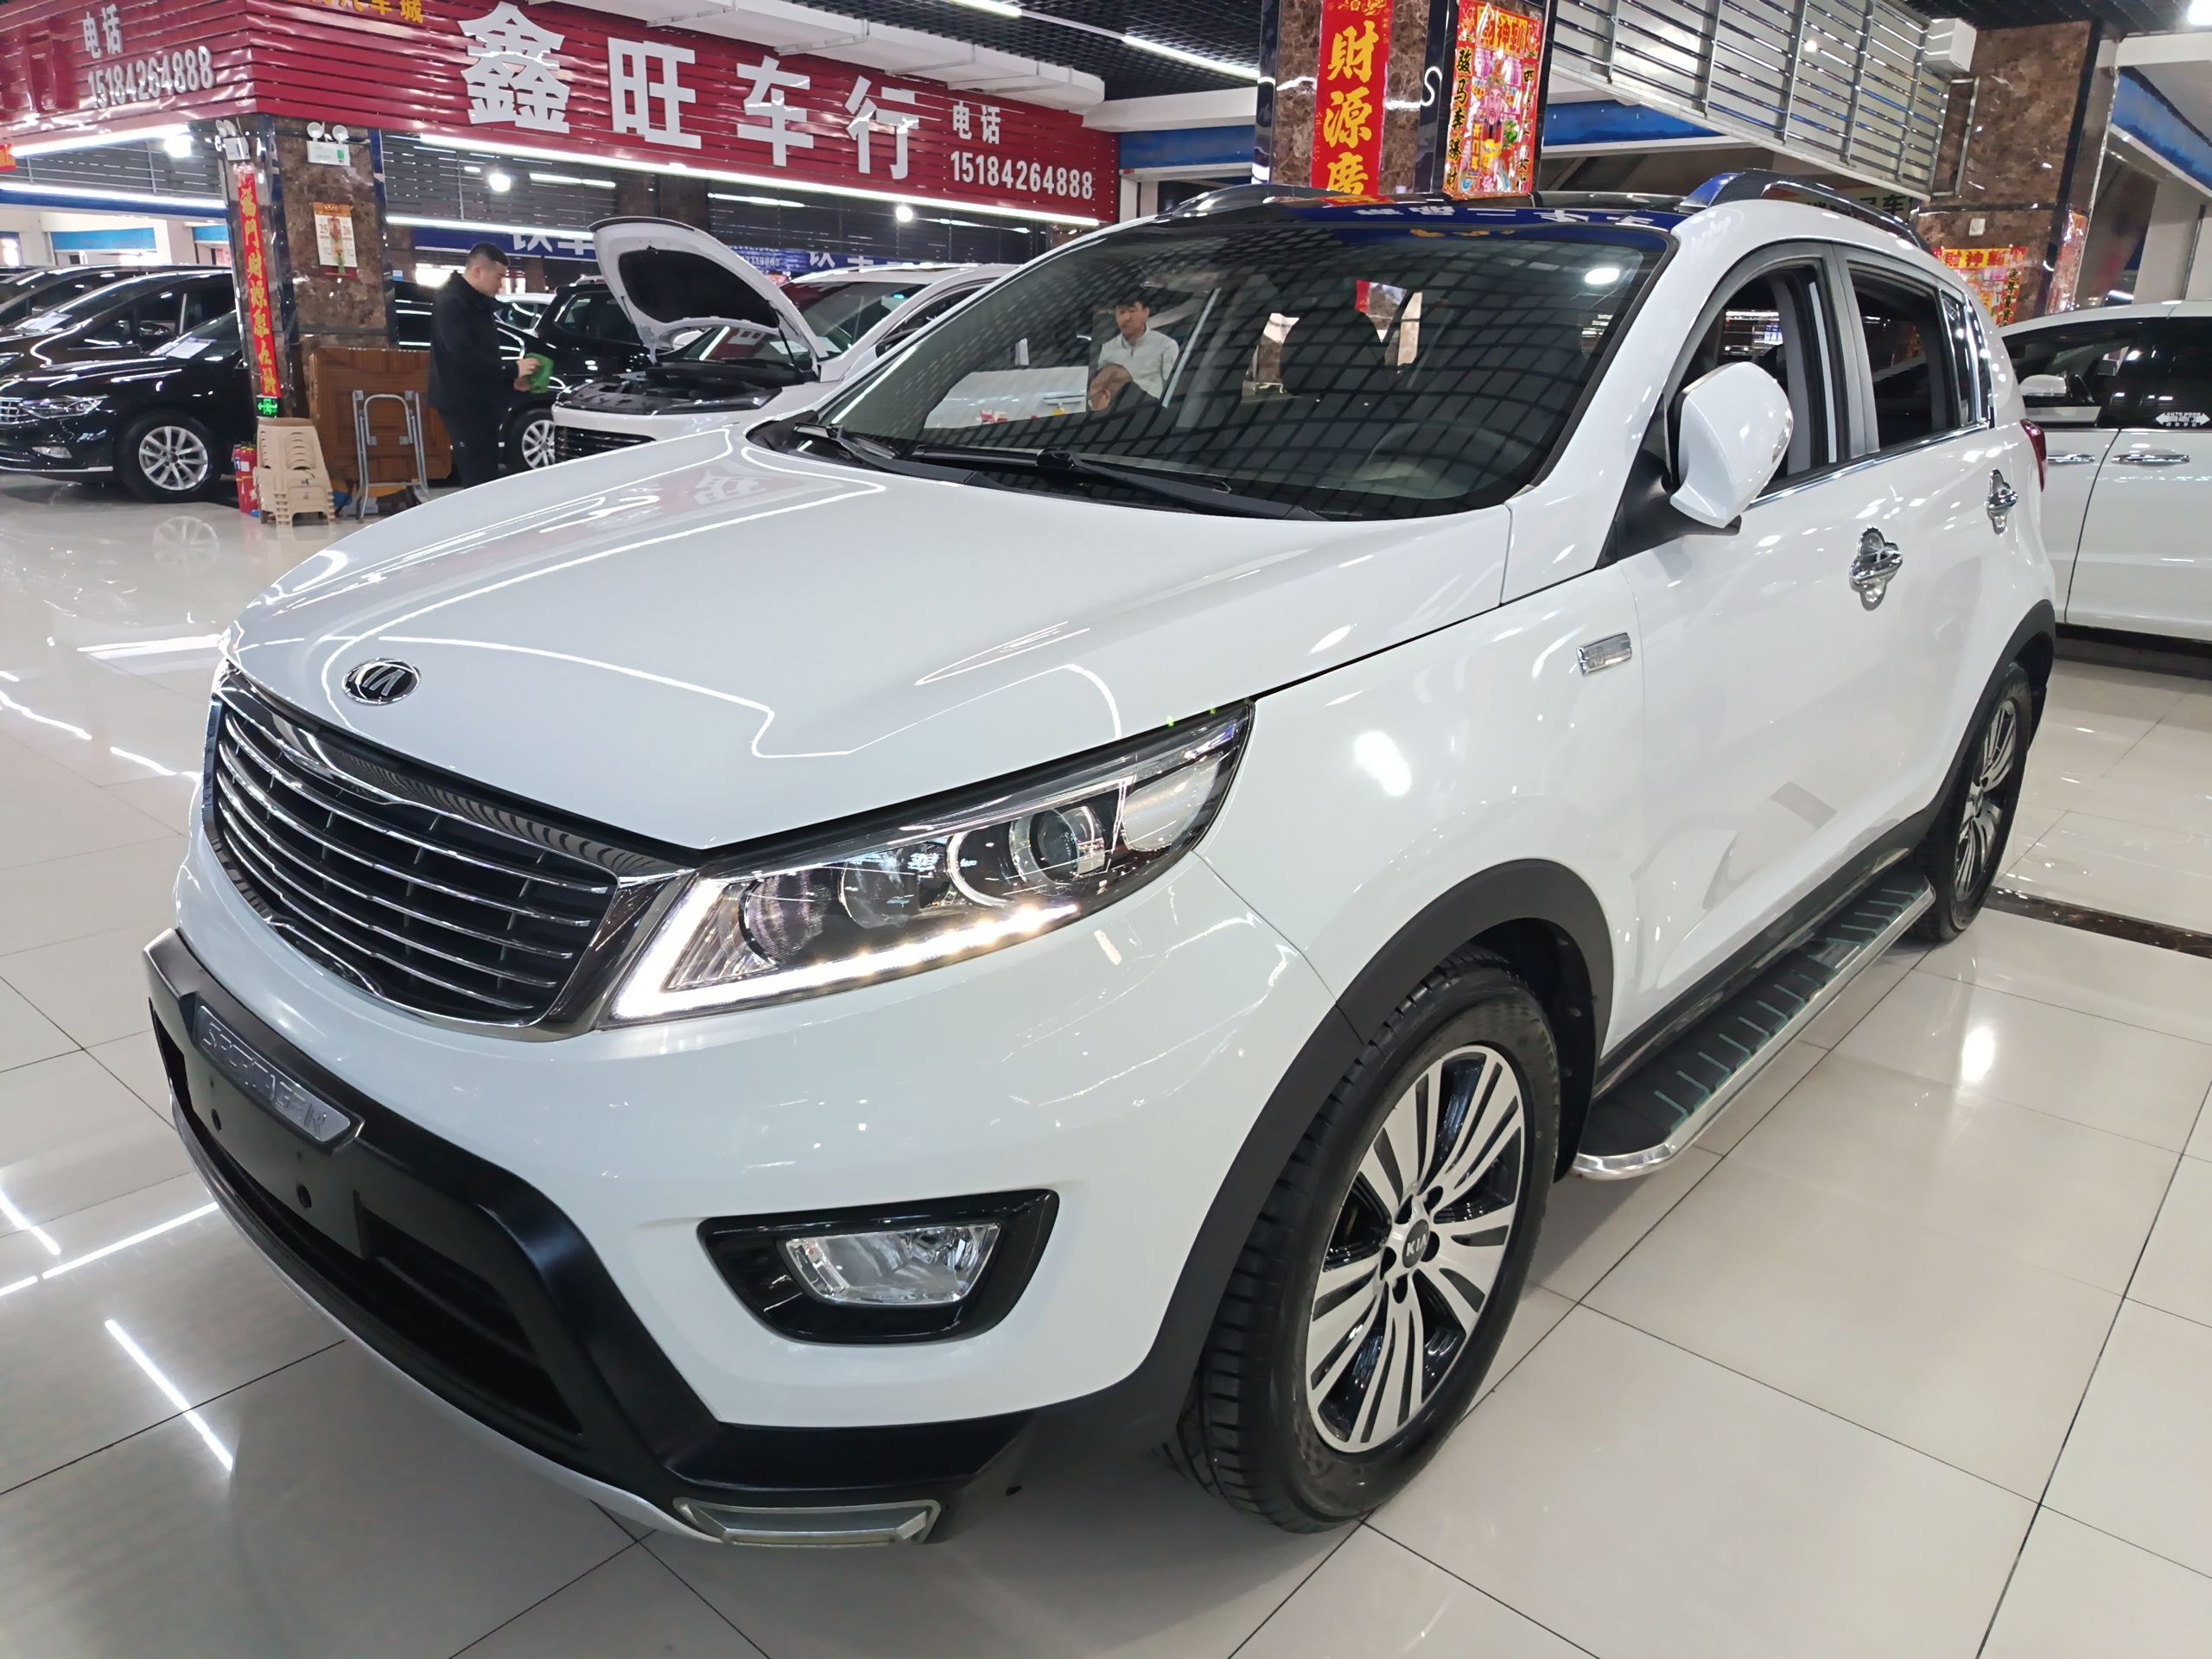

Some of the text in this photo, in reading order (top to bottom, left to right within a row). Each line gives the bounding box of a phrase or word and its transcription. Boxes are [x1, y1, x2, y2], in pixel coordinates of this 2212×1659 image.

[83, 3, 124, 59] 电话
[87, 46, 214, 109] 15184264888
[458, 1, 919, 180] 鑫旺车行
[953, 100, 1001, 144] 电话
[950, 150, 1093, 200] 15184264888
[1406, 1233, 1427, 1256] KIA
